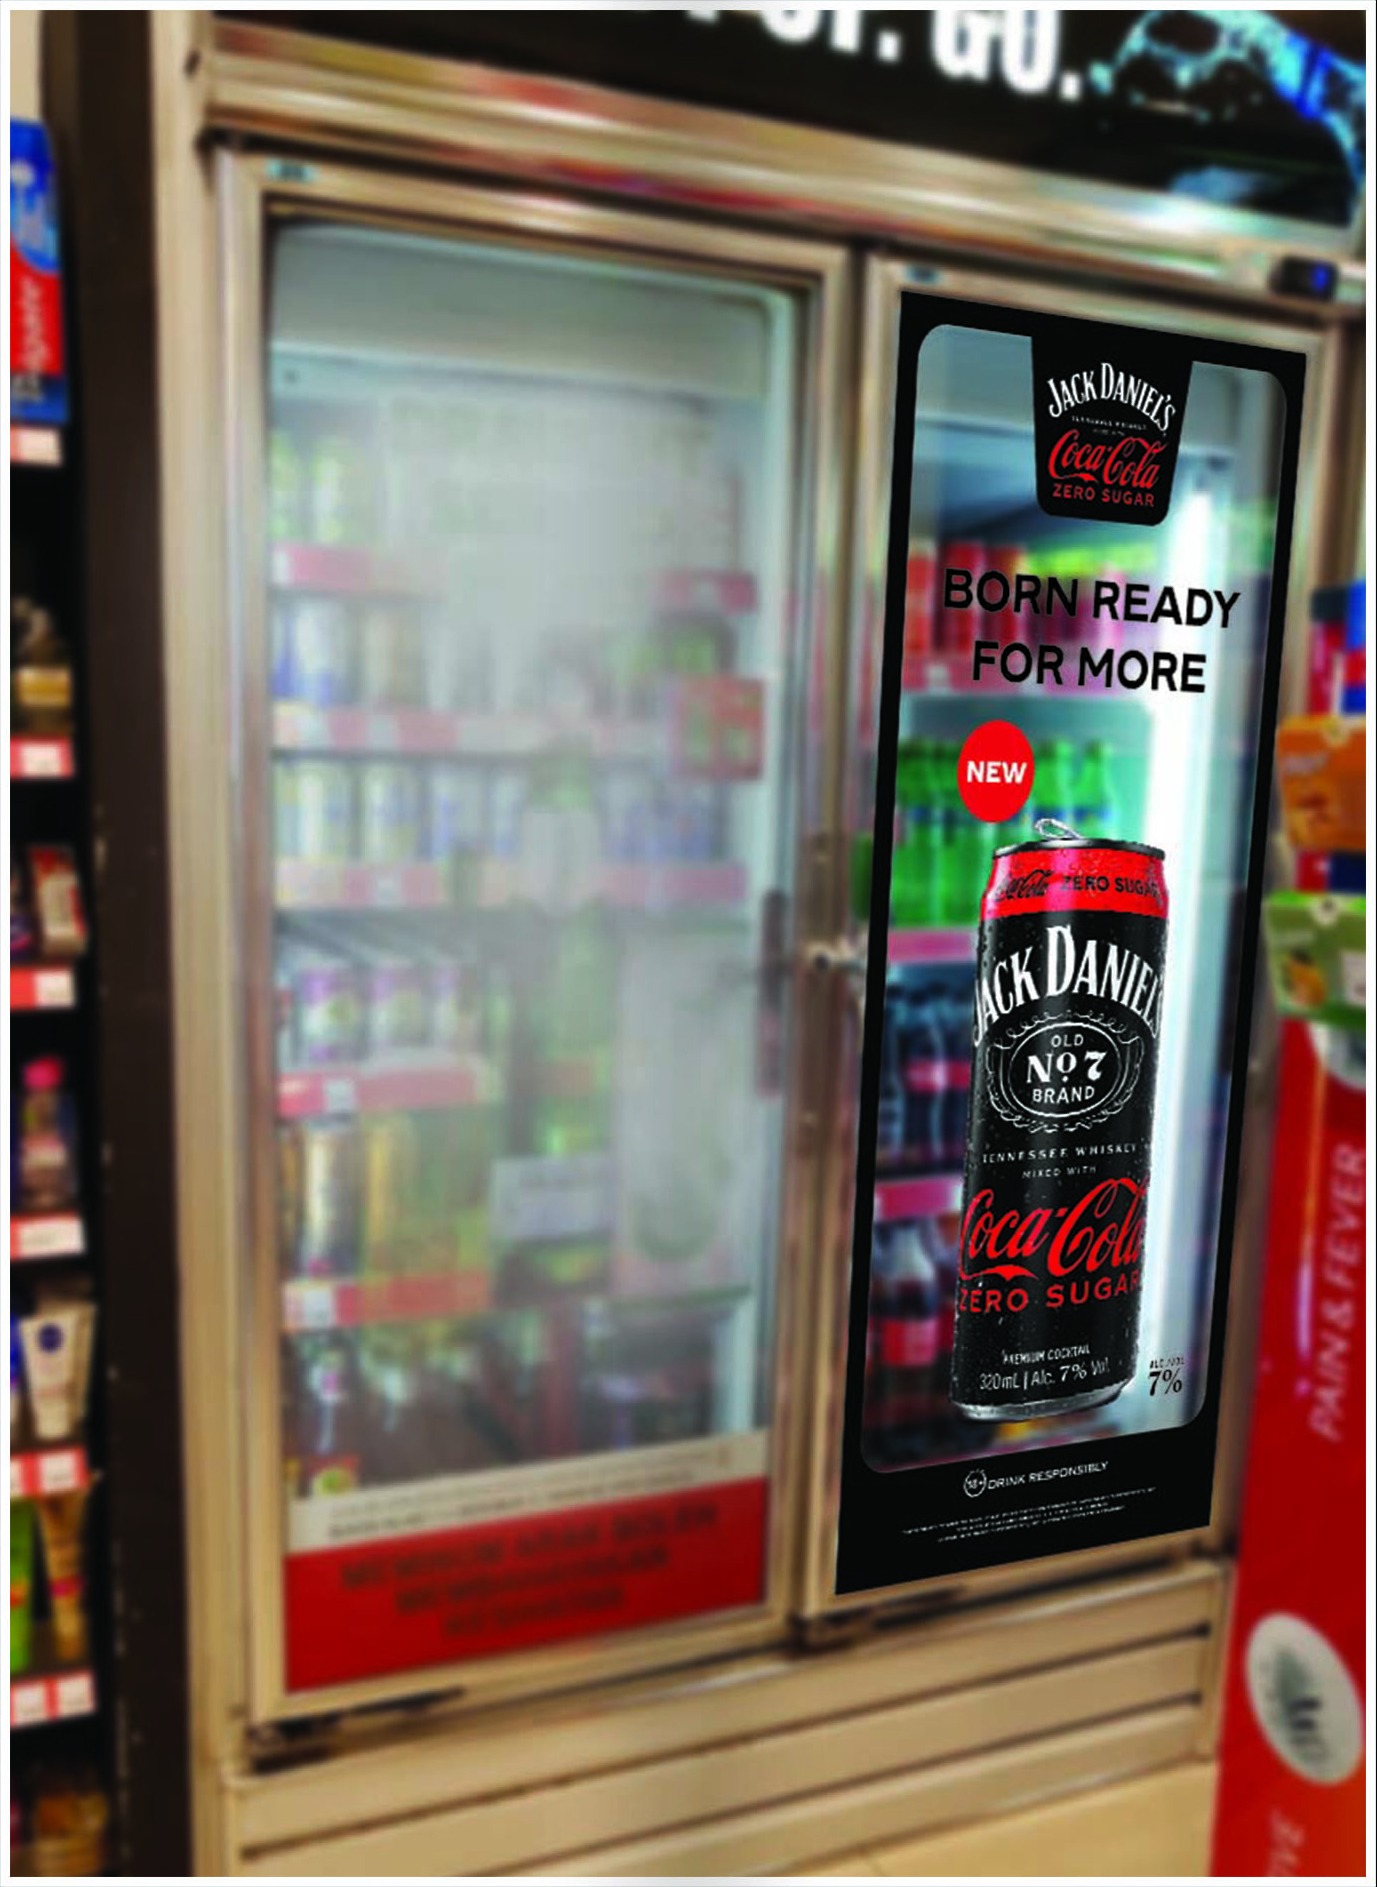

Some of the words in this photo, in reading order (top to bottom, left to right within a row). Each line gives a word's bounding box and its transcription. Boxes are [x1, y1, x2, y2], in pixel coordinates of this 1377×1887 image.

[1047, 371, 1098, 418] JACK
[1048, 429, 1168, 489] Coca-Cola
[1052, 483, 1096, 501] ZERO
[1101, 488, 1155, 508] SUGAR
[944, 569, 1079, 617] BORN
[1092, 580, 1241, 629] READY
[972, 640, 1064, 685] FOR
[1077, 646, 1207, 693] MORE
[967, 760, 1028, 784] NEW
[1062, 876, 1110, 892] ZERO
[1051, 1033, 1084, 1048] OLD
[1032, 1085, 1095, 1105] BRAND
[960, 1288, 1029, 1313] ZERO
[1046, 1270, 1140, 1309] SUGAR
[1060, 1364, 1087, 1382] 7%
[1147, 1367, 1183, 1397] 7%
[988, 1474, 1026, 1490] DRINK
